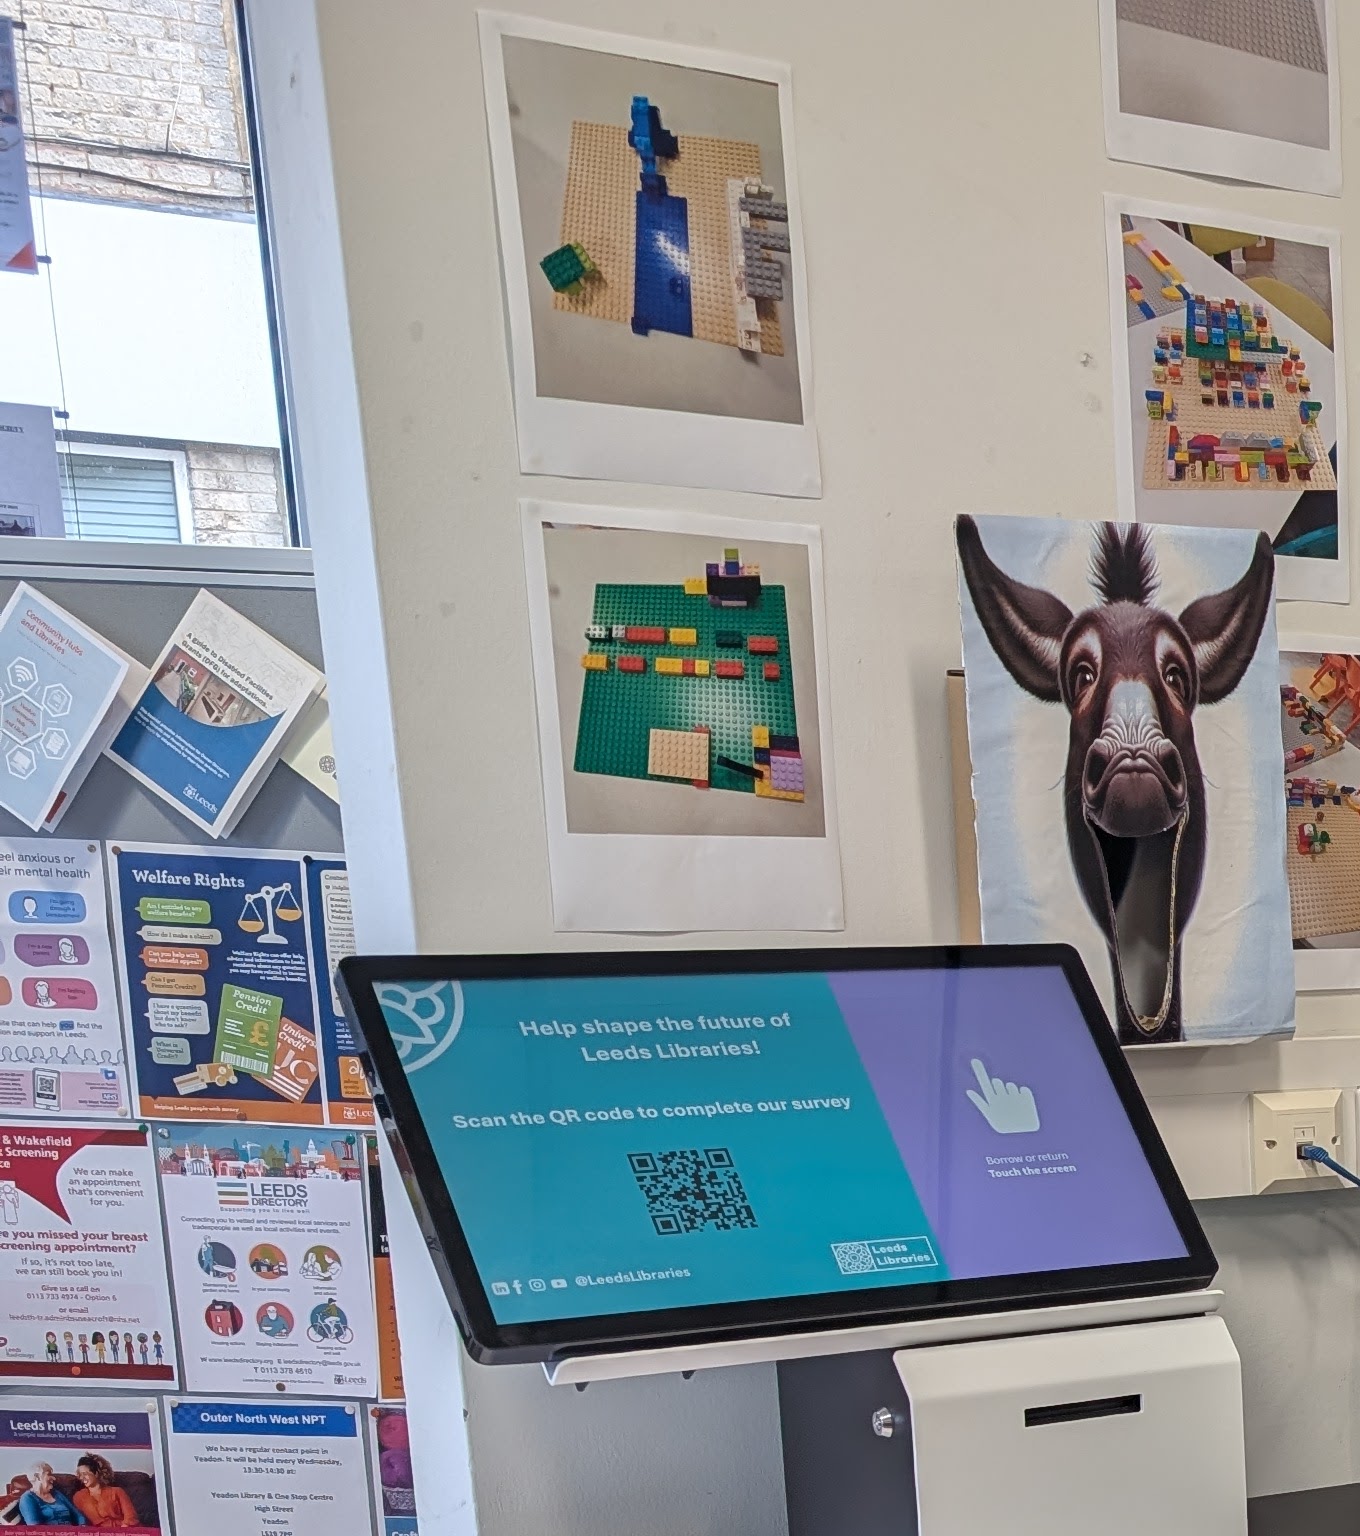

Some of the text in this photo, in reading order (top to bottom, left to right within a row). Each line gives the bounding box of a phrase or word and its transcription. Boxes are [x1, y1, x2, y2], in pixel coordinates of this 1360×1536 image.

[18, 854, 75, 864] anxious or
[14, 867, 90, 879] mental health
[132, 870, 245, 889] Welfare Rights
[232, 990, 272, 1006] Pension
[235, 1001, 268, 1015] Credit
[519, 1012, 792, 1038] Help shape the future of
[278, 1032, 306, 1051] Credit
[581, 1040, 761, 1062] Leeds Libraries!
[452, 1095, 851, 1129] Scan the QR code to complete our survey
[3, 1136, 72, 1147] & Wakefield
[6, 1147, 59, 1160] Screening
[986, 1156, 1023, 1165] Borrow
[1038, 1153, 1069, 1161] return
[73, 1167, 89, 1177] We
[109, 1169, 134, 1177] make
[988, 1165, 1077, 1178] Touch the screen
[83, 1178, 141, 1188] appointment
[68, 1187, 144, 1197] that's convenient
[250, 1183, 308, 1197] LEEDS
[252, 1198, 308, 1207] DIRECTORY
[12, 1230, 148, 1241] you missed your breast
[54, 1243, 136, 1255] appointment?
[872, 1243, 908, 1254] Leeds
[877, 1252, 931, 1265] Libraries
[67, 1268, 90, 1276] book
[92, 1269, 108, 1278] you
[575, 1267, 691, 1287] @LeedsLibraries
[201, 1413, 326, 1424] Outer North West NPT
[10, 1420, 116, 1432] Leeds Homeshare
